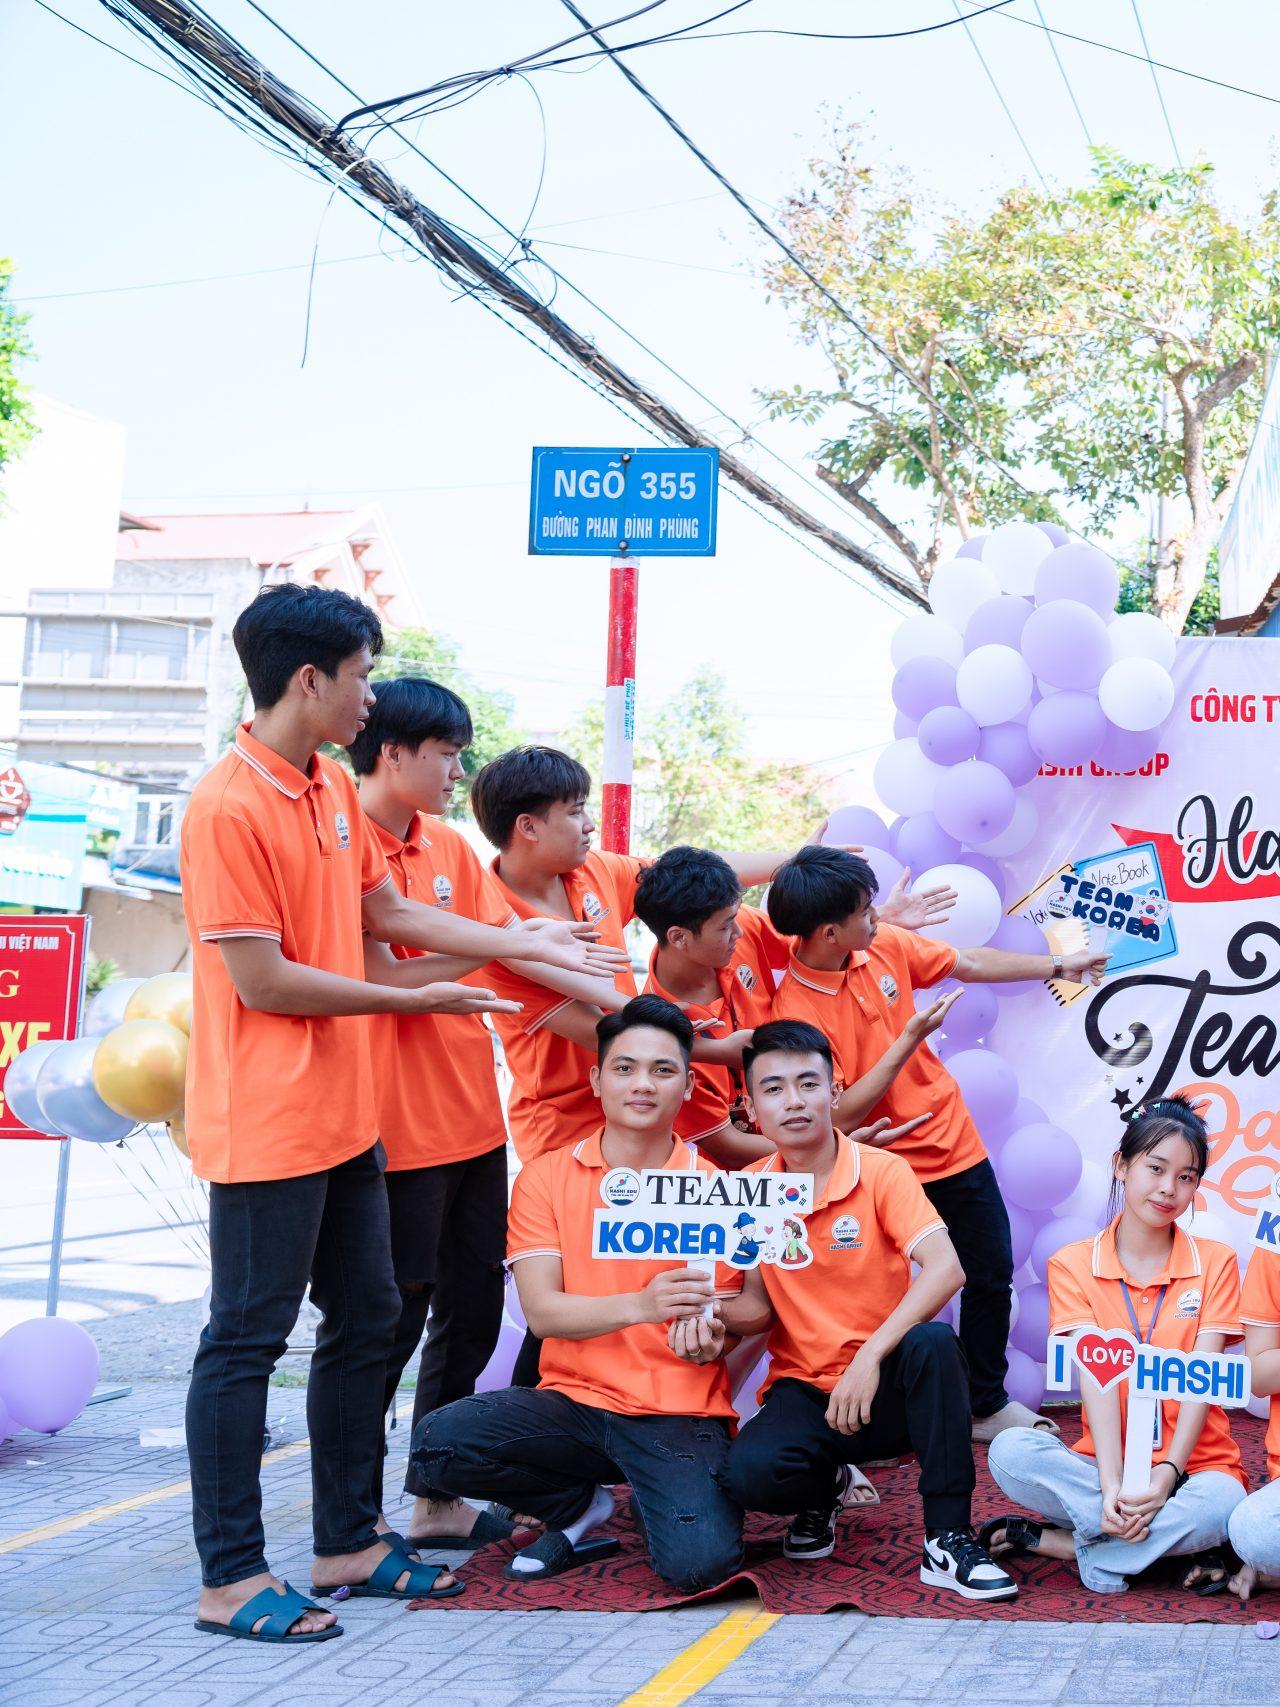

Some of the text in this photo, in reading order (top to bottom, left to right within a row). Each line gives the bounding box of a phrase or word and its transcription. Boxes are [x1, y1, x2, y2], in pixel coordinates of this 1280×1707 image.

[553, 461, 697, 500] NGÕ 355
[542, 510, 699, 539] ĐƯỜNG PHAN ĐÌNH PHÙNG
[1190, 687, 1256, 723] CÔNG
[1060, 874, 1134, 912] TEAM
[1072, 900, 1161, 943] KOREA
[9, 933, 32, 953] VIỆT
[33, 936, 60, 950] NAM
[646, 1174, 773, 1208] TEAM
[599, 1220, 726, 1256] KOREA
[1055, 1344, 1245, 1399] I LOVE HASHI
